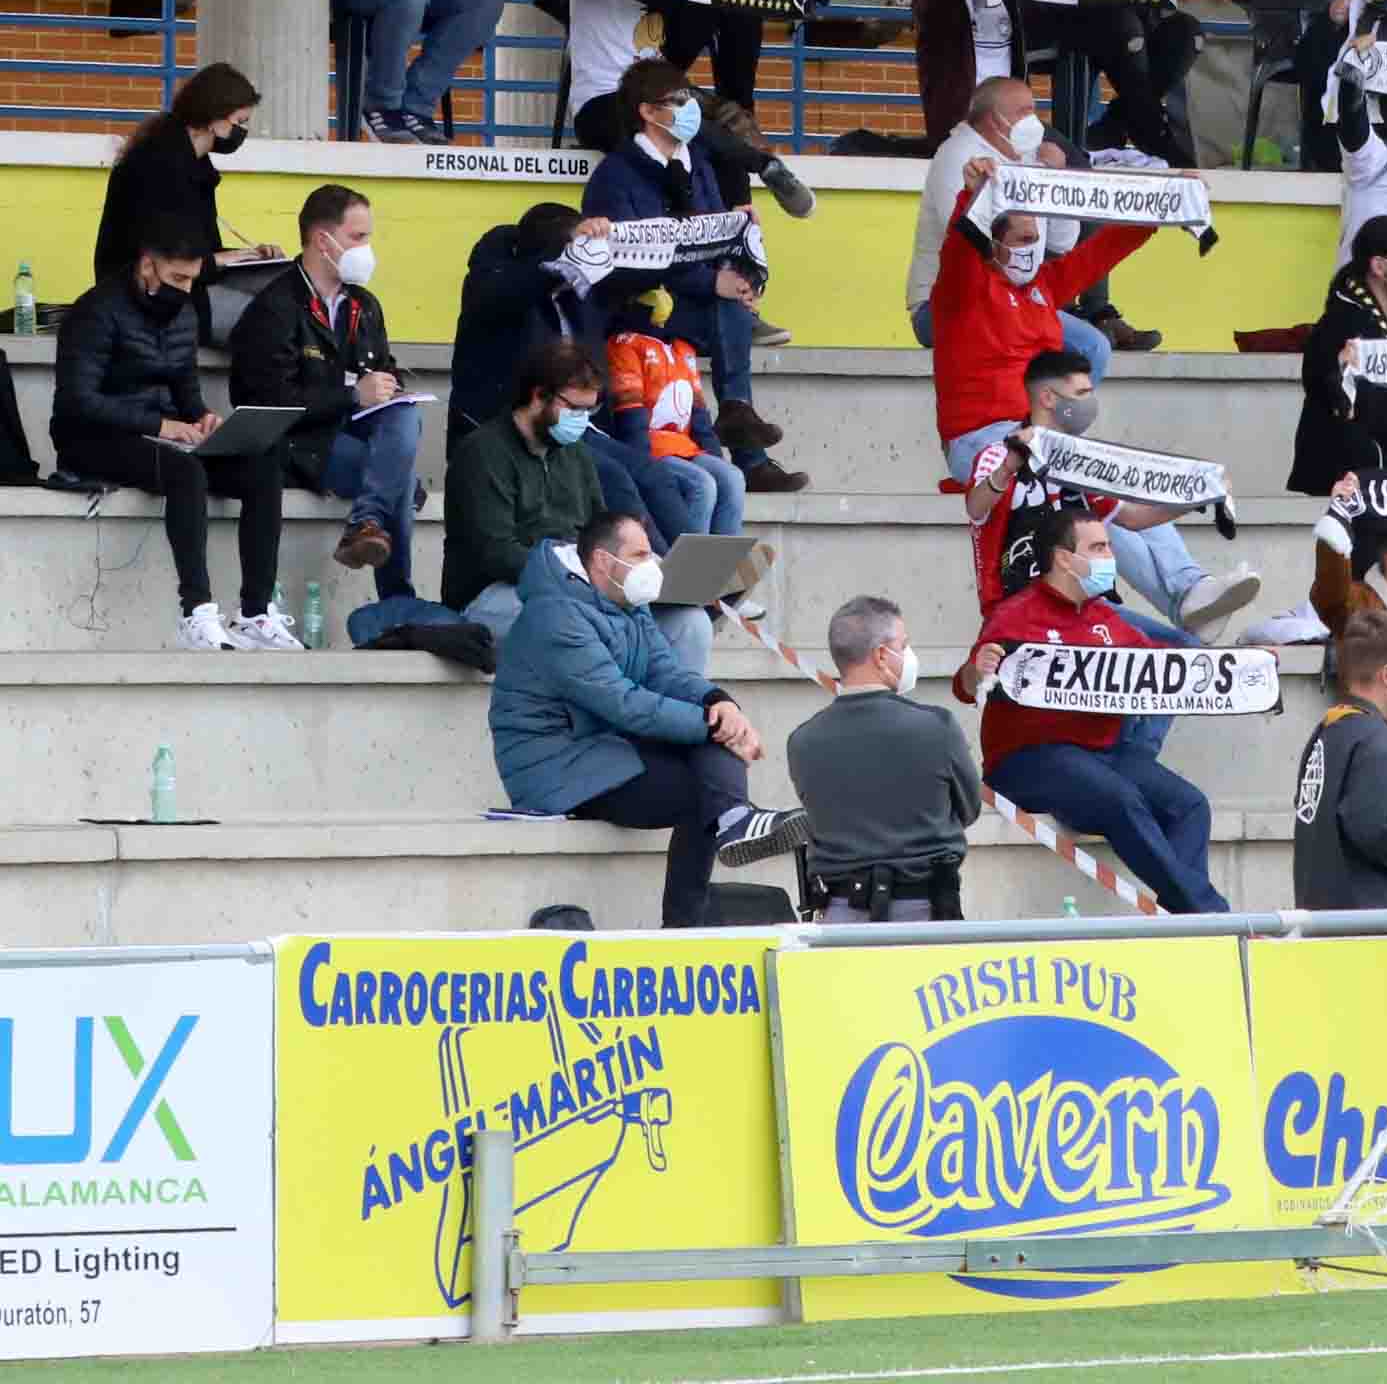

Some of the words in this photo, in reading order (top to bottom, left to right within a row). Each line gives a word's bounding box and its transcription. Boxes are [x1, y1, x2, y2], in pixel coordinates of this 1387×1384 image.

[425, 152, 510, 173] PERSONAL
[513, 156, 543, 175] DEL
[547, 157, 590, 176] CLUB
[1112, 190, 1182, 220] RODRIGO
[1143, 470, 1208, 502] RODRIGO
[1043, 690, 1126, 710] UNIONISTAS
[1130, 693, 1148, 711] DE
[1150, 695, 1233, 712] SALAMANCA
[298, 941, 549, 1028] CARROCERIAS
[559, 940, 761, 1020] CARBAJOSA
[914, 954, 1039, 1036] IRISH
[1052, 957, 1139, 1023] PUB
[510, 1025, 666, 1138] MARTÍN
[835, 1040, 1231, 1231] Cavern
[54, 1245, 181, 1279] Lighting
[79, 1299, 102, 1324] 57
